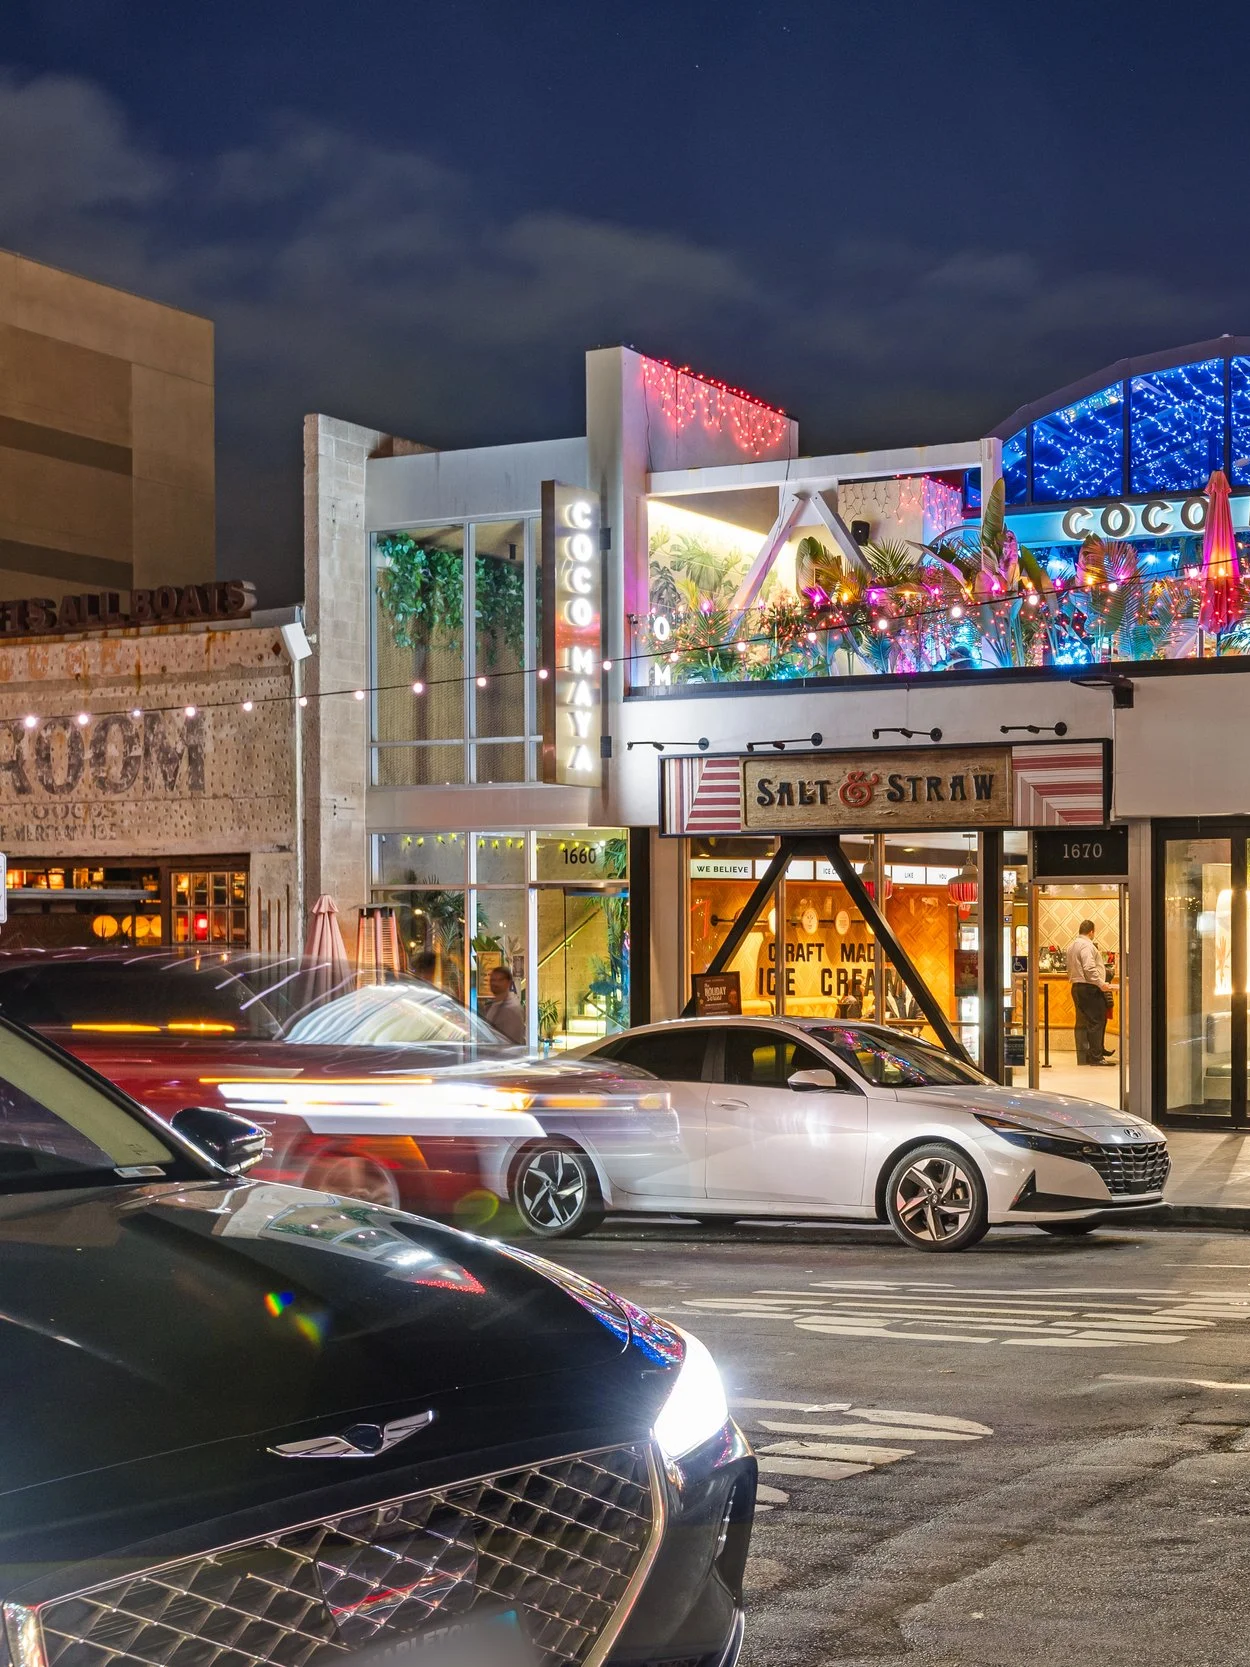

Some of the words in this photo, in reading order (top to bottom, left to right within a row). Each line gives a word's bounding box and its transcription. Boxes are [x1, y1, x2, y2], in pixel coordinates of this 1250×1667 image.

[1062, 497, 1210, 541] COCO
[565, 500, 593, 628] COCO
[131, 580, 257, 618] BOATS
[566, 646, 594, 772] MAYA
[757, 777, 832, 807] SALT
[838, 771, 879, 808] &
[886, 773, 995, 803] STRAW
[563, 847, 598, 865] 1660
[1063, 842, 1103, 859] 1670
[696, 865, 711, 873] WE
[713, 866, 749, 874] BELIEVE
[759, 967, 796, 996] ICE
